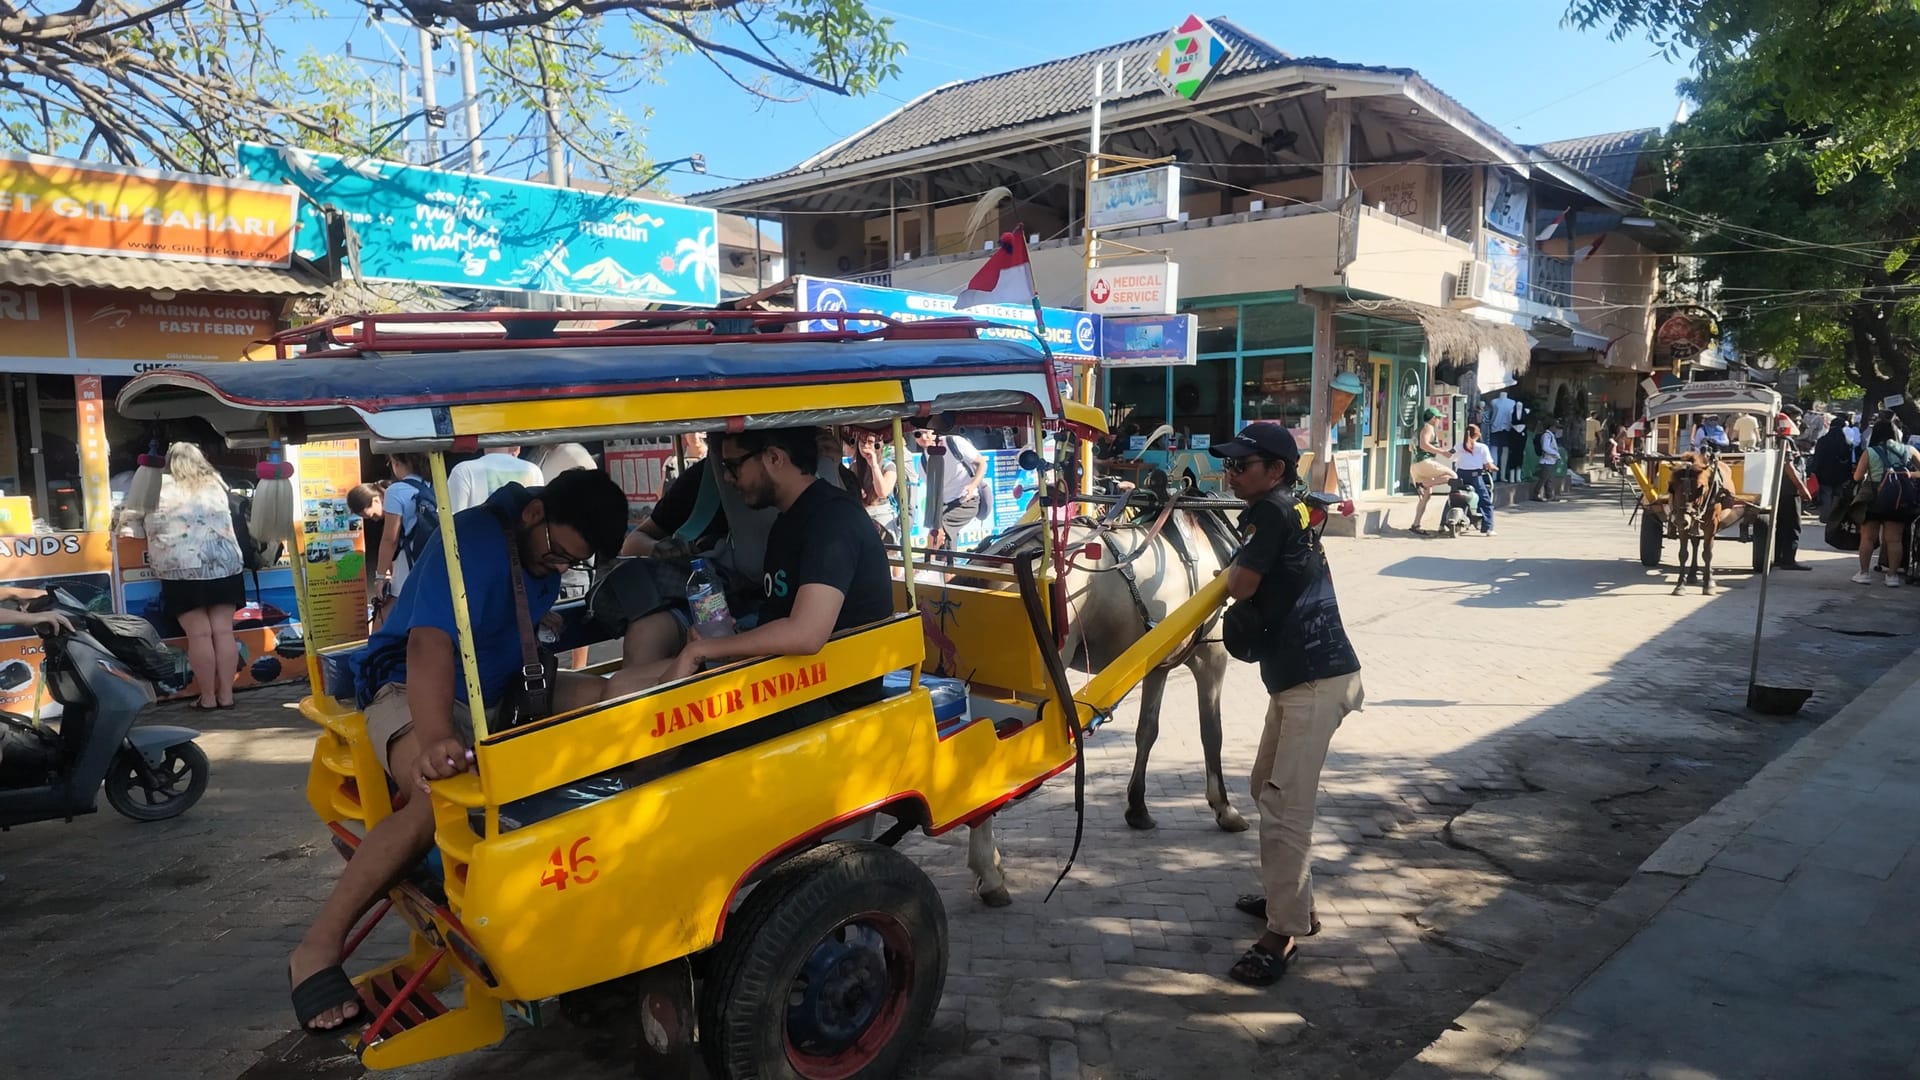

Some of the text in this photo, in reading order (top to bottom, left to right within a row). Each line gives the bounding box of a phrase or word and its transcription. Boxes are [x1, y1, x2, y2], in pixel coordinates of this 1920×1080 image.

[1175, 52, 1199, 65] MART
[52, 196, 129, 223] GILI
[143, 207, 276, 237] BAHARI
[378, 211, 395, 226] to
[416, 194, 485, 234] night
[411, 224, 501, 252] market
[1113, 274, 1163, 289] MEDICAL
[1113, 289, 1160, 303] SERVICE
[138, 303, 271, 321] MARINA GROUP
[922, 299, 1024, 319] OFFIAL TICKET
[159, 321, 255, 336] FAST FERRY
[133, 362, 182, 373] CHE
[650, 661, 827, 738] JANUR INDAH
[540, 836, 600, 891] 46
